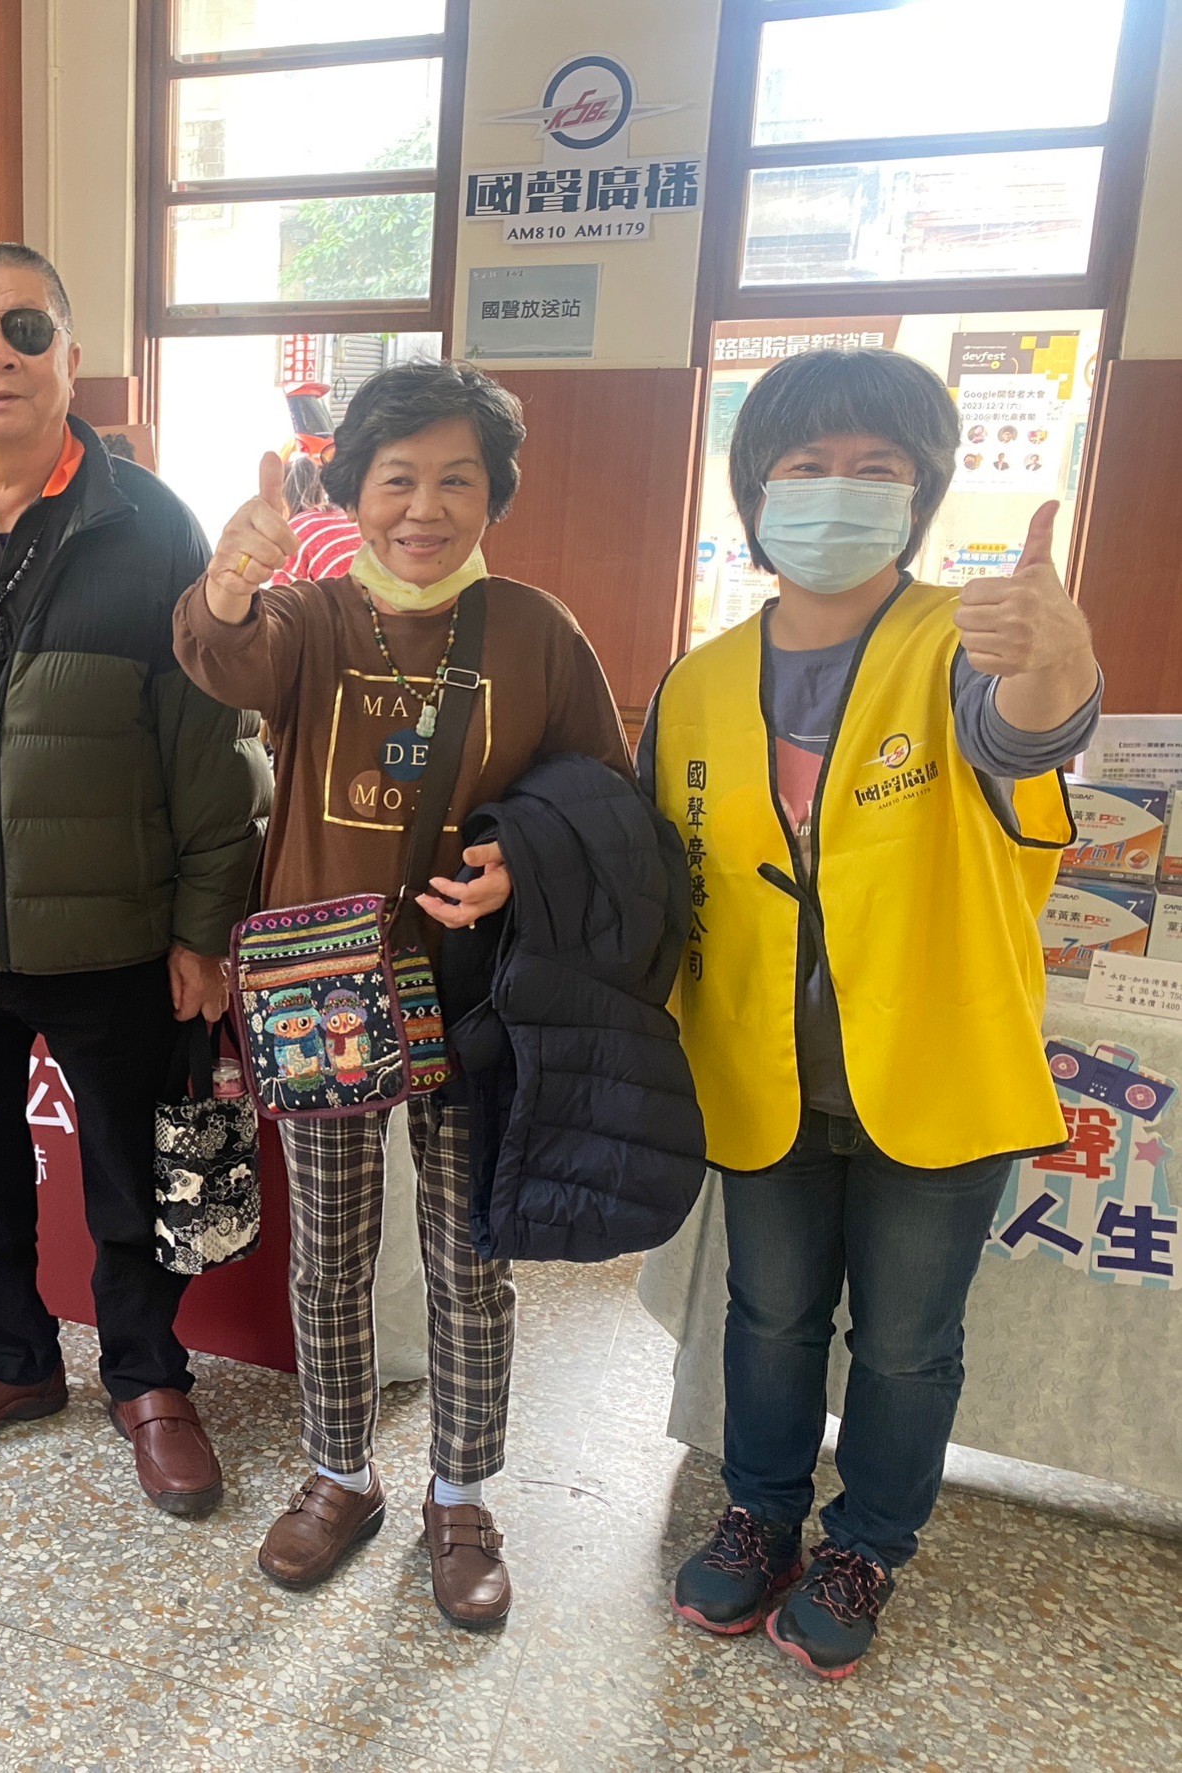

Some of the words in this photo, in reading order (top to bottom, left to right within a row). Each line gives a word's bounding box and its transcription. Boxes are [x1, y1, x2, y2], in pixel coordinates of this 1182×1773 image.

[466, 160, 701, 217] 國聲廣播
[507, 225, 566, 240] AM810
[574, 222, 645, 238] AM1179
[481, 298, 581, 320] 國聲放送站
[962, 352, 1006, 362] devfest
[961, 566, 986, 576] 12/8
[1076, 838, 1093, 858] 7
[1113, 841, 1126, 860] 1
[1061, 937, 1079, 957] 7
[986, 1192, 1178, 1277] 人生
